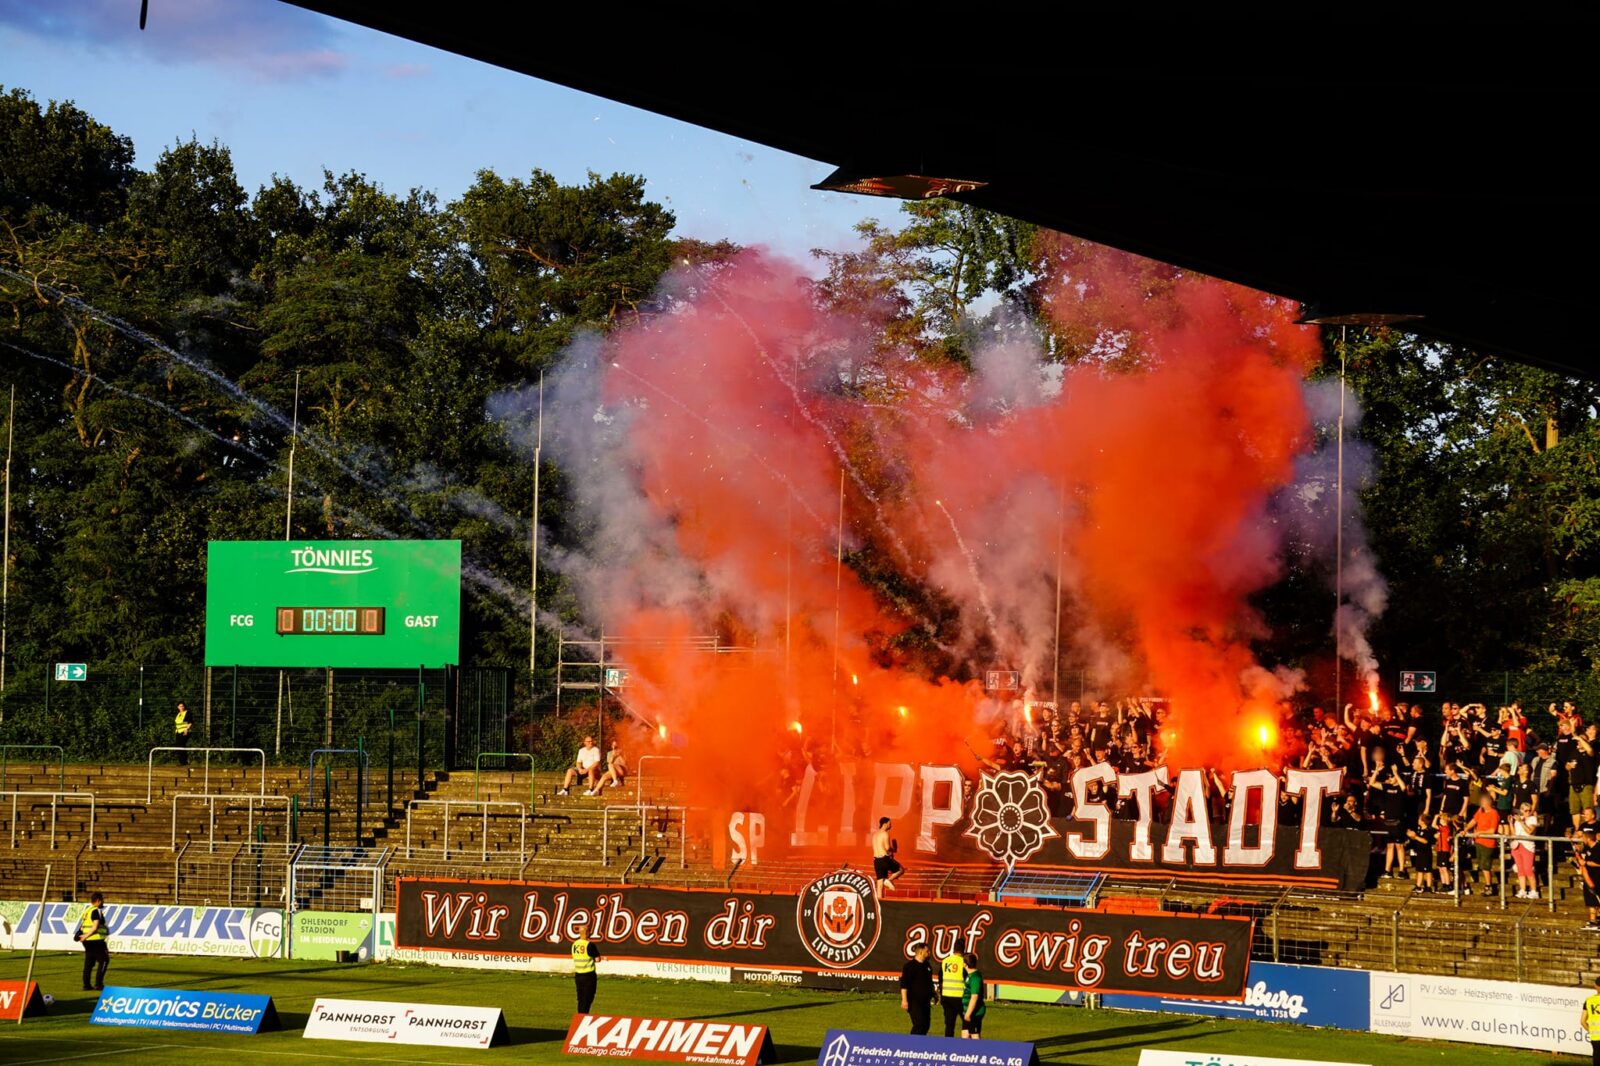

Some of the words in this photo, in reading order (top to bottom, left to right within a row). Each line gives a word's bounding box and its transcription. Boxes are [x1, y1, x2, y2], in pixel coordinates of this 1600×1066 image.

[291, 546, 373, 567] TÖNNIES
[230, 614, 254, 627] FCG
[302, 608, 357, 632] 00:00
[405, 615, 439, 628] GAST
[1066, 762, 1344, 869] STADT
[811, 873, 871, 897] SPIELVEREIN
[804, 909, 811, 917] 19
[74, 905, 195, 938] UZKA
[300, 918, 348, 926] OHLENDORF
[255, 921, 280, 937] FCG
[300, 926, 335, 934] STADION
[312, 936, 357, 945] HEIDEWALD
[422, 892, 507, 939] Wir
[521, 892, 687, 946] bleiben
[705, 898, 773, 949] dir
[904, 911, 991, 961] auf
[996, 920, 1109, 987] ewig
[1125, 931, 1224, 980] treu
[171, 940, 249, 954] Auto-Service.
[573, 944, 585, 955] K9
[811, 937, 866, 961] LIPPSTADT
[379, 948, 449, 961] VERSICHERUNG
[655, 963, 728, 975] VERSICHERUNG
[944, 962, 958, 973] K9
[1438, 986, 1457, 996] Solar
[1464, 988, 1513, 1002] Heizsysteme
[112, 995, 200, 1018] euronics
[202, 1003, 261, 1021] Bücker
[1255, 1009, 1270, 1017] est.
[319, 1011, 396, 1025] PANNHORST
[409, 1017, 487, 1030] PANNHORST
[350, 1026, 390, 1034] ENTSORGUNG
[440, 1031, 481, 1039] ENTSORGUNG
[569, 1015, 762, 1057] KAHMEN
[1421, 1015, 1592, 1043] www.aulenkamp.de
[568, 1045, 608, 1057] TransCargo
[609, 1047, 633, 1057] GmbH
[852, 1046, 892, 1057] Friedrich
[893, 1049, 948, 1061] Amtenbrink
[949, 1053, 978, 1063] GmbH
[979, 1056, 987, 1064] &
[989, 1056, 1005, 1065] Co.
[1007, 1058, 1023, 1066] KG
[686, 1055, 746, 1066] www.kahmen.de
